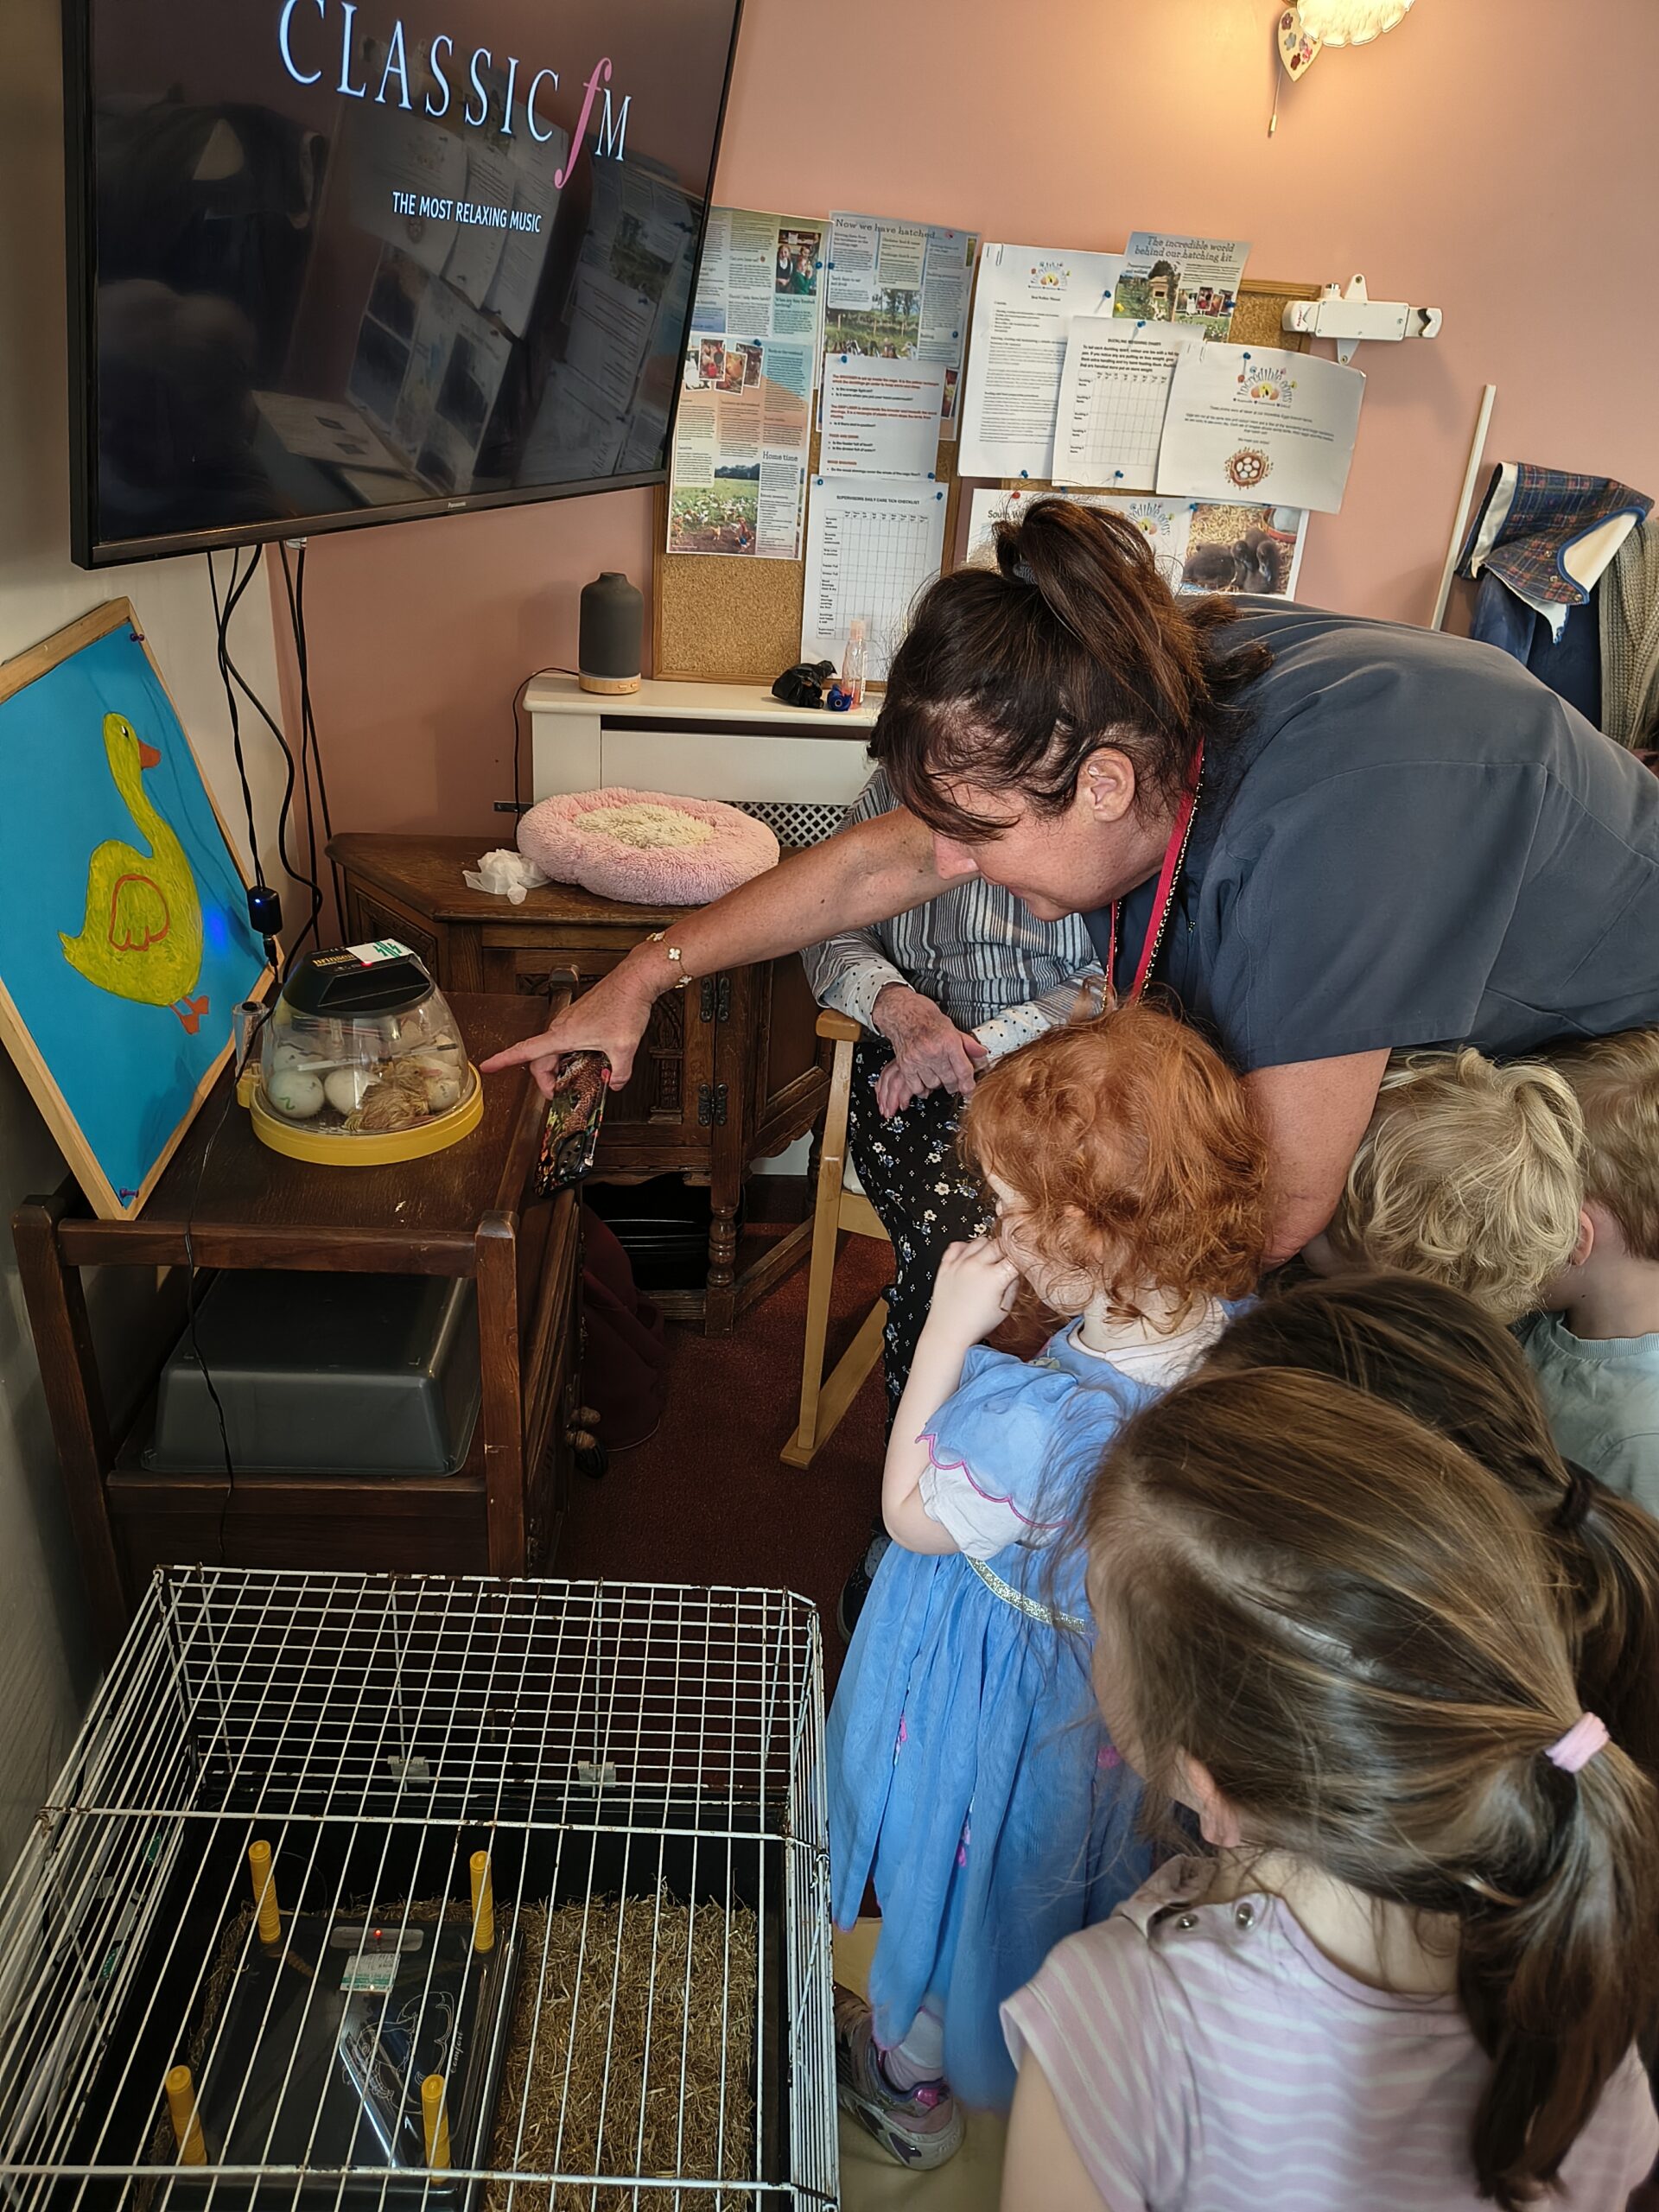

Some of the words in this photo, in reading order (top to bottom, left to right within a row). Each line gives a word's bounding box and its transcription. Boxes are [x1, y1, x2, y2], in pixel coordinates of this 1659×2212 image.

[278, 0, 559, 143] CLASSIC
[392, 191, 416, 217] THE
[419, 197, 454, 221] MOST
[455, 200, 508, 229] RELAXING
[509, 213, 542, 234] MUSIC
[836, 218, 856, 229] Now
[874, 223, 896, 234] have
[1147, 235, 1163, 247] The
[1165, 239, 1208, 251] incredible
[1210, 242, 1235, 252] world
[1135, 245, 1164, 257] behind
[1181, 249, 1219, 263] hatching
[763, 451, 782, 461] Home
[783, 454, 799, 462] time
